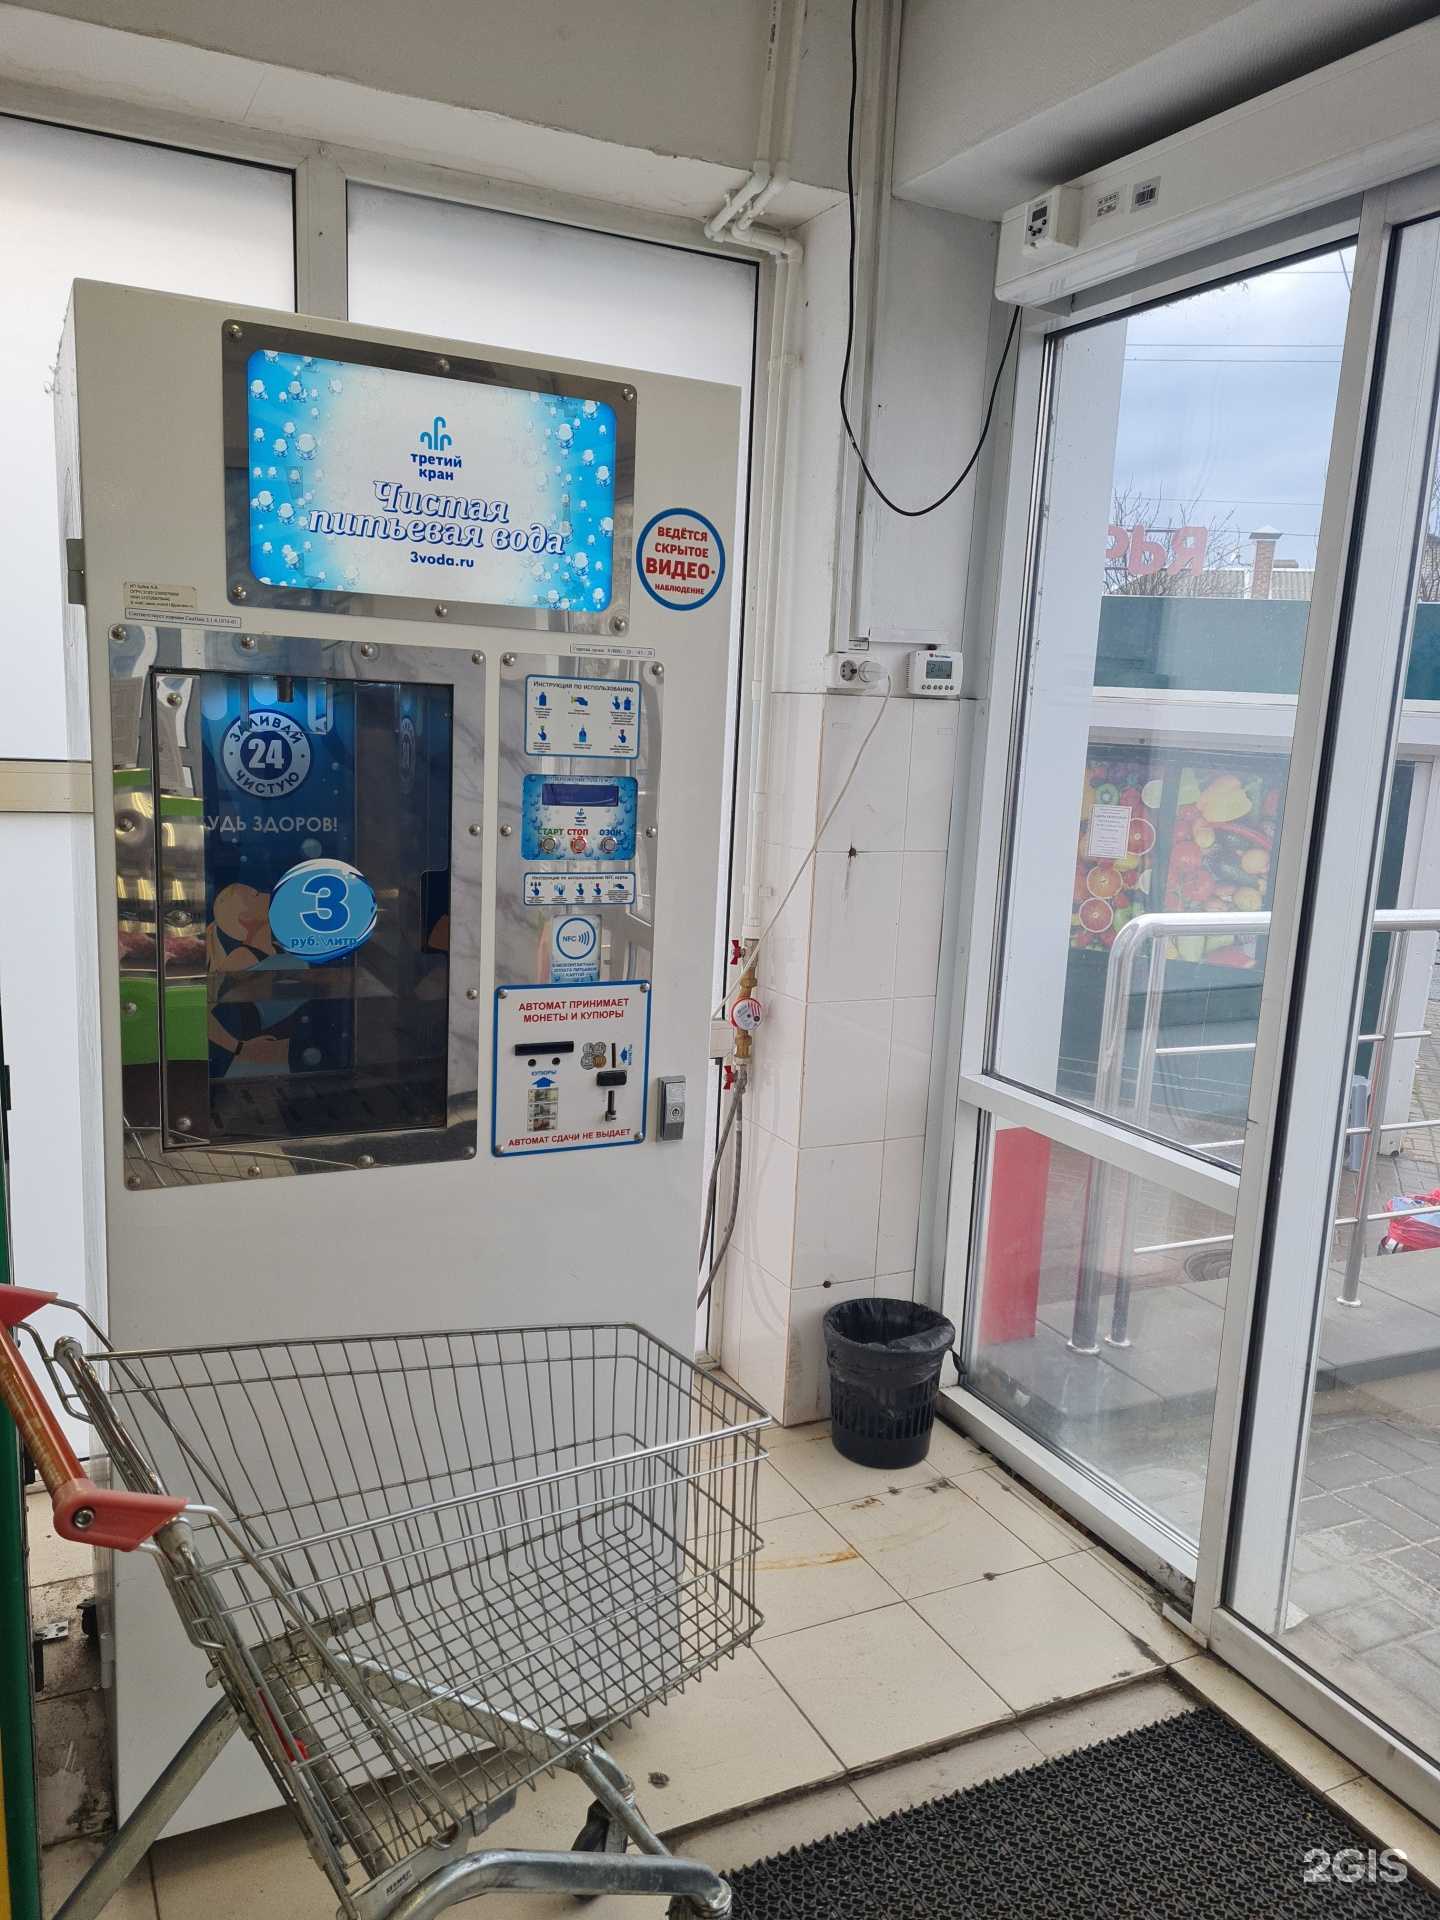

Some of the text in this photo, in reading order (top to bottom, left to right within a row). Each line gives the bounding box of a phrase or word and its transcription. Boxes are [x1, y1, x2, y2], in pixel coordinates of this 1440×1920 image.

[410, 452, 463, 470] третий
[418, 467, 454, 482] кран
[372, 480, 510, 524] Чистая
[308, 509, 566, 555] питьевая вода
[657, 526, 708, 542] ВЕДЁТСЯ
[654, 542, 709, 558] СКРЫТОЕ
[410, 551, 474, 568] 3voda.ru
[654, 583, 705, 595] НАБЛЮДЕНИЕ
[248, 738, 285, 769] 24
[236, 769, 299, 794] ЧИСТУЮ
[253, 815, 338, 833] ЗДОРОВ!
[300, 874, 351, 934] 3
[291, 935, 319, 949] руб.
[562, 935, 577, 943] NFC
[519, 998, 630, 1012] АВТОМАТ ПРИНИМАЕТ
[523, 1010, 625, 1024] МОНЕТЫ И КУПЮРЫ
[508, 1128, 632, 1147] АВТОМАТ СДАЧИ НЕ ВЫДАЕТ
